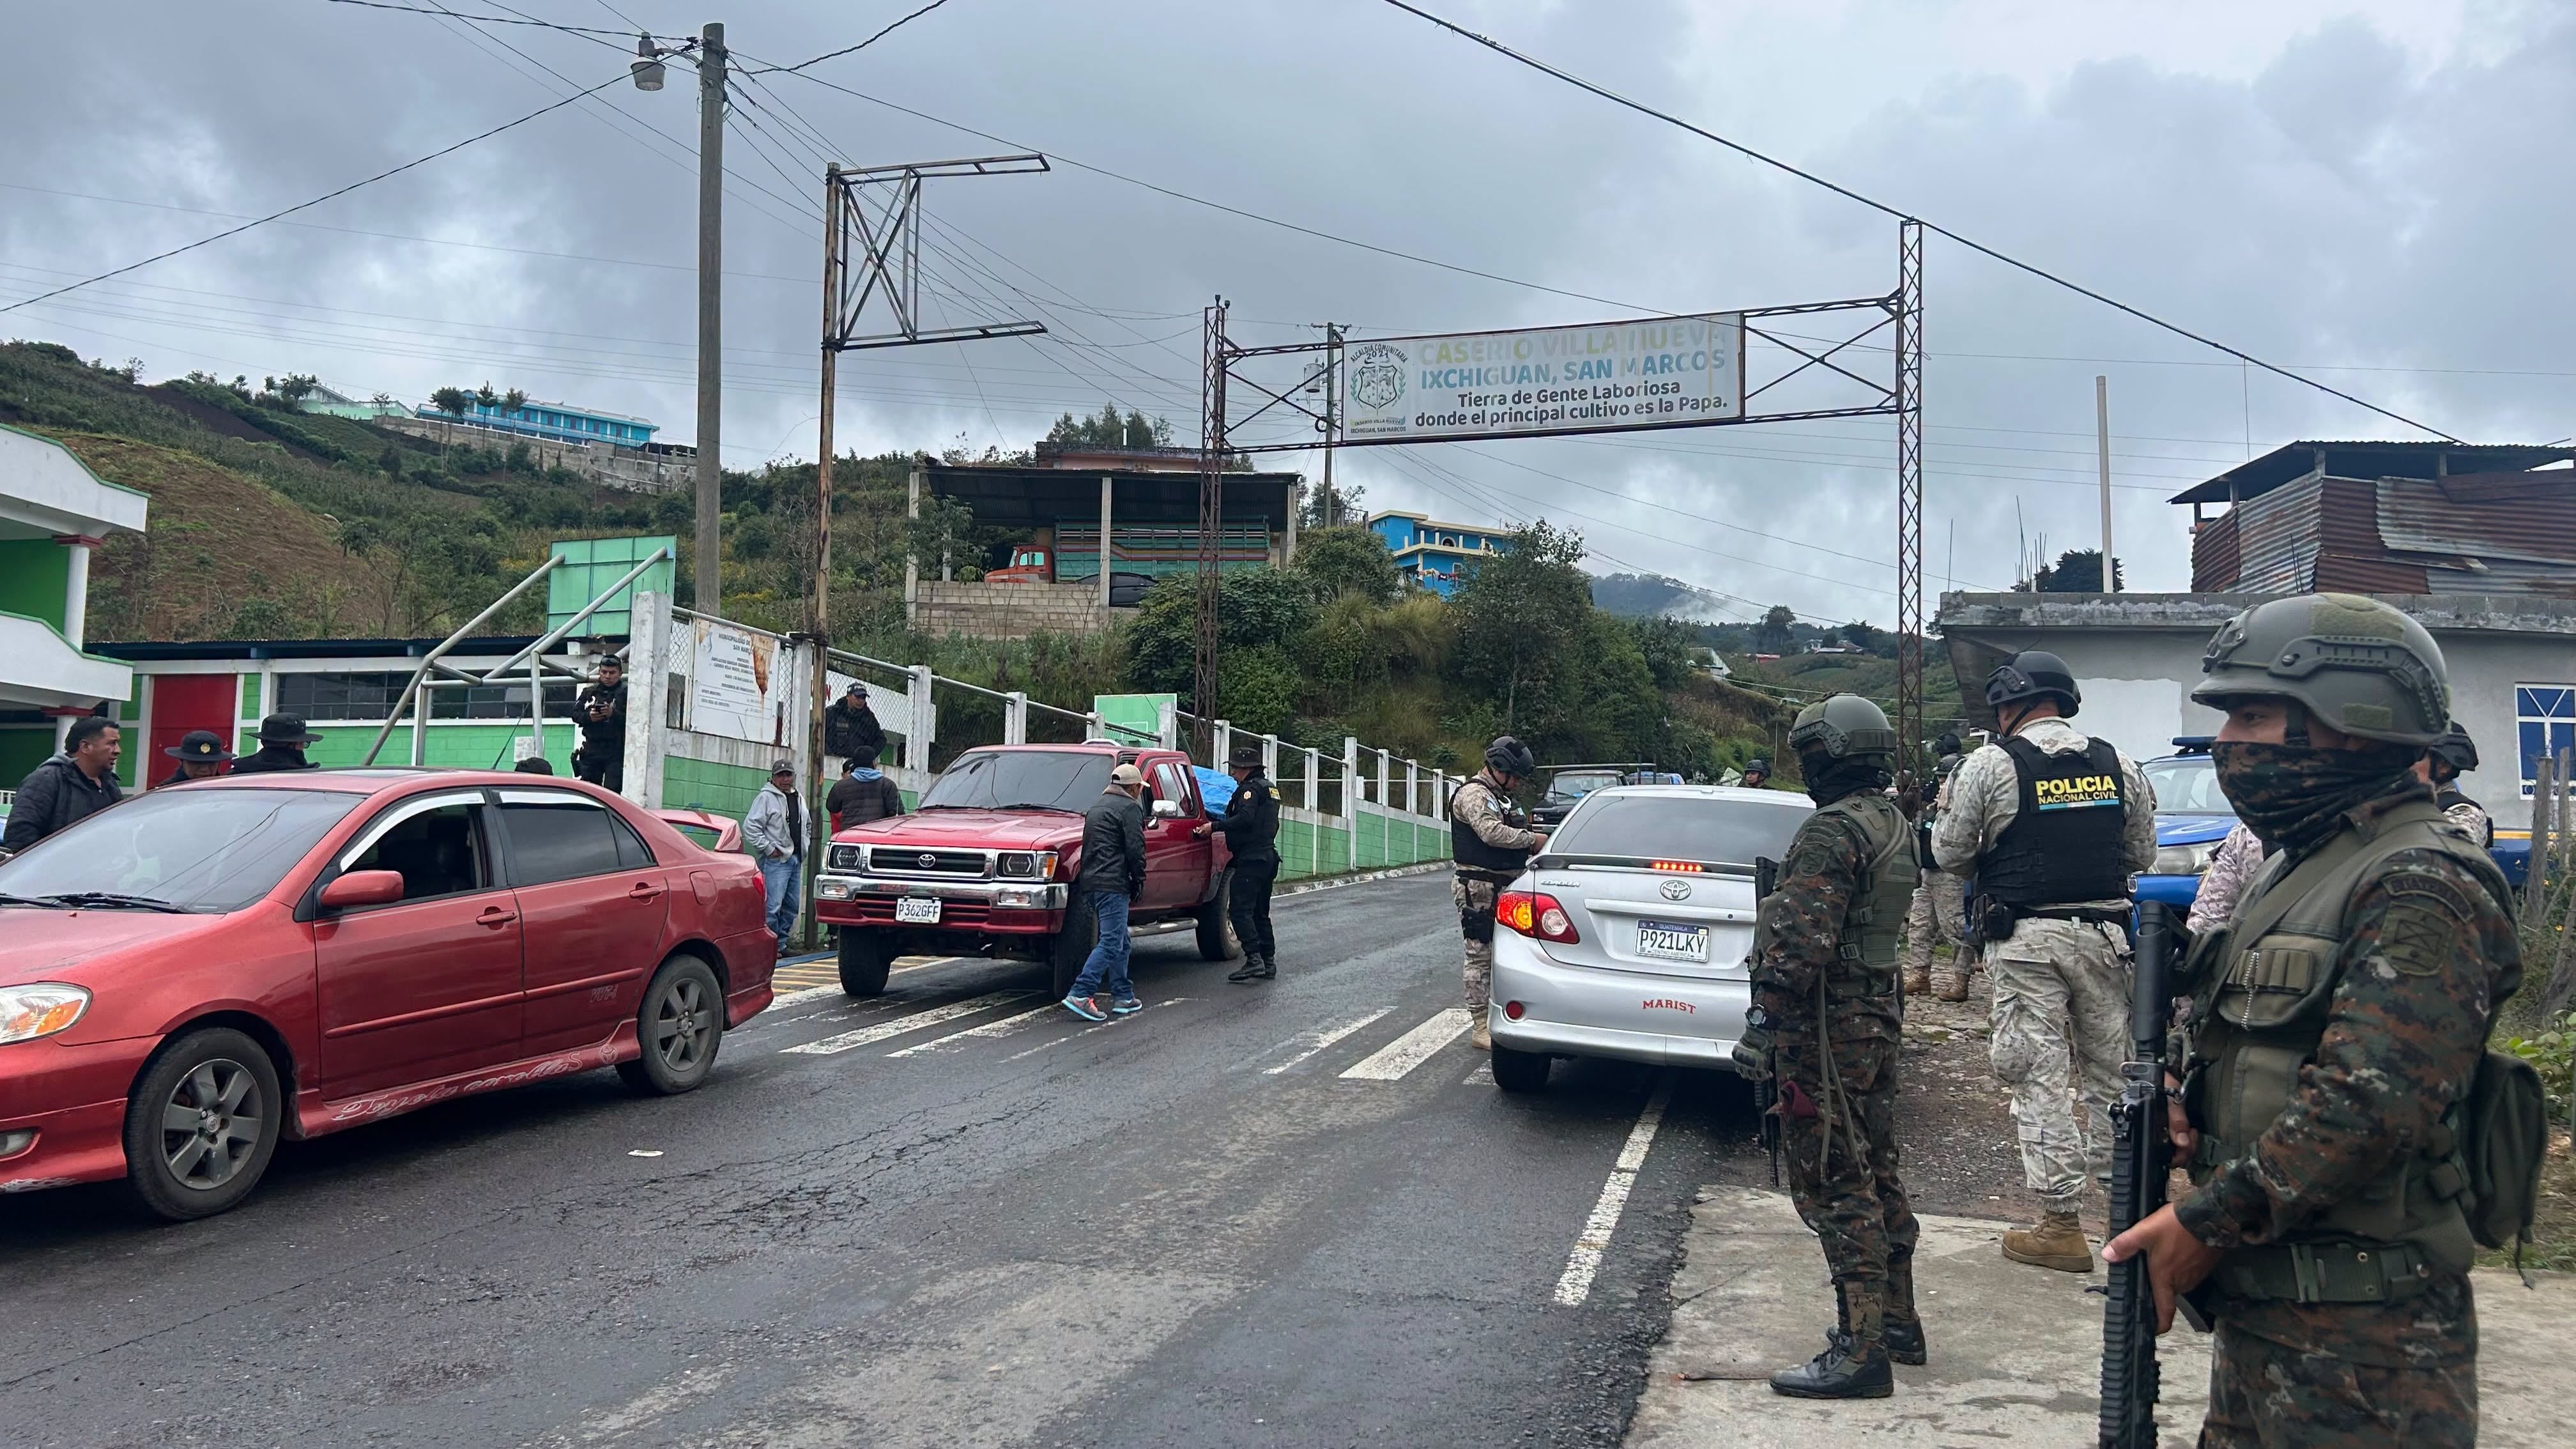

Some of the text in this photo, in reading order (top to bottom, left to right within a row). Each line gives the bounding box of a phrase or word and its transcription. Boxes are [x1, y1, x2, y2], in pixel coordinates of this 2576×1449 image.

[1350, 344, 1408, 363] ALCALDIA COMUNITARIA
[1367, 350, 1388, 360] 2021
[1420, 337, 1533, 365] CASERIO
[1542, 331, 1615, 358] VILLA
[1422, 349, 1725, 389] IXCHIGUAN, SAN MARCOS
[1458, 380, 1680, 407] Tierra de Gente Laboriosa
[1415, 395, 1728, 427] donde el principal cultivo es la Papa.
[2035, 776, 2117, 795] POLICIA
[2038, 791, 2119, 804] NACIONAL CIVIL
[898, 903, 939, 917] P362GFF
[1640, 930, 1705, 953] P921LKY
[1643, 999, 1696, 1015] MARIST
[332, 1085, 459, 1121] Toyota
